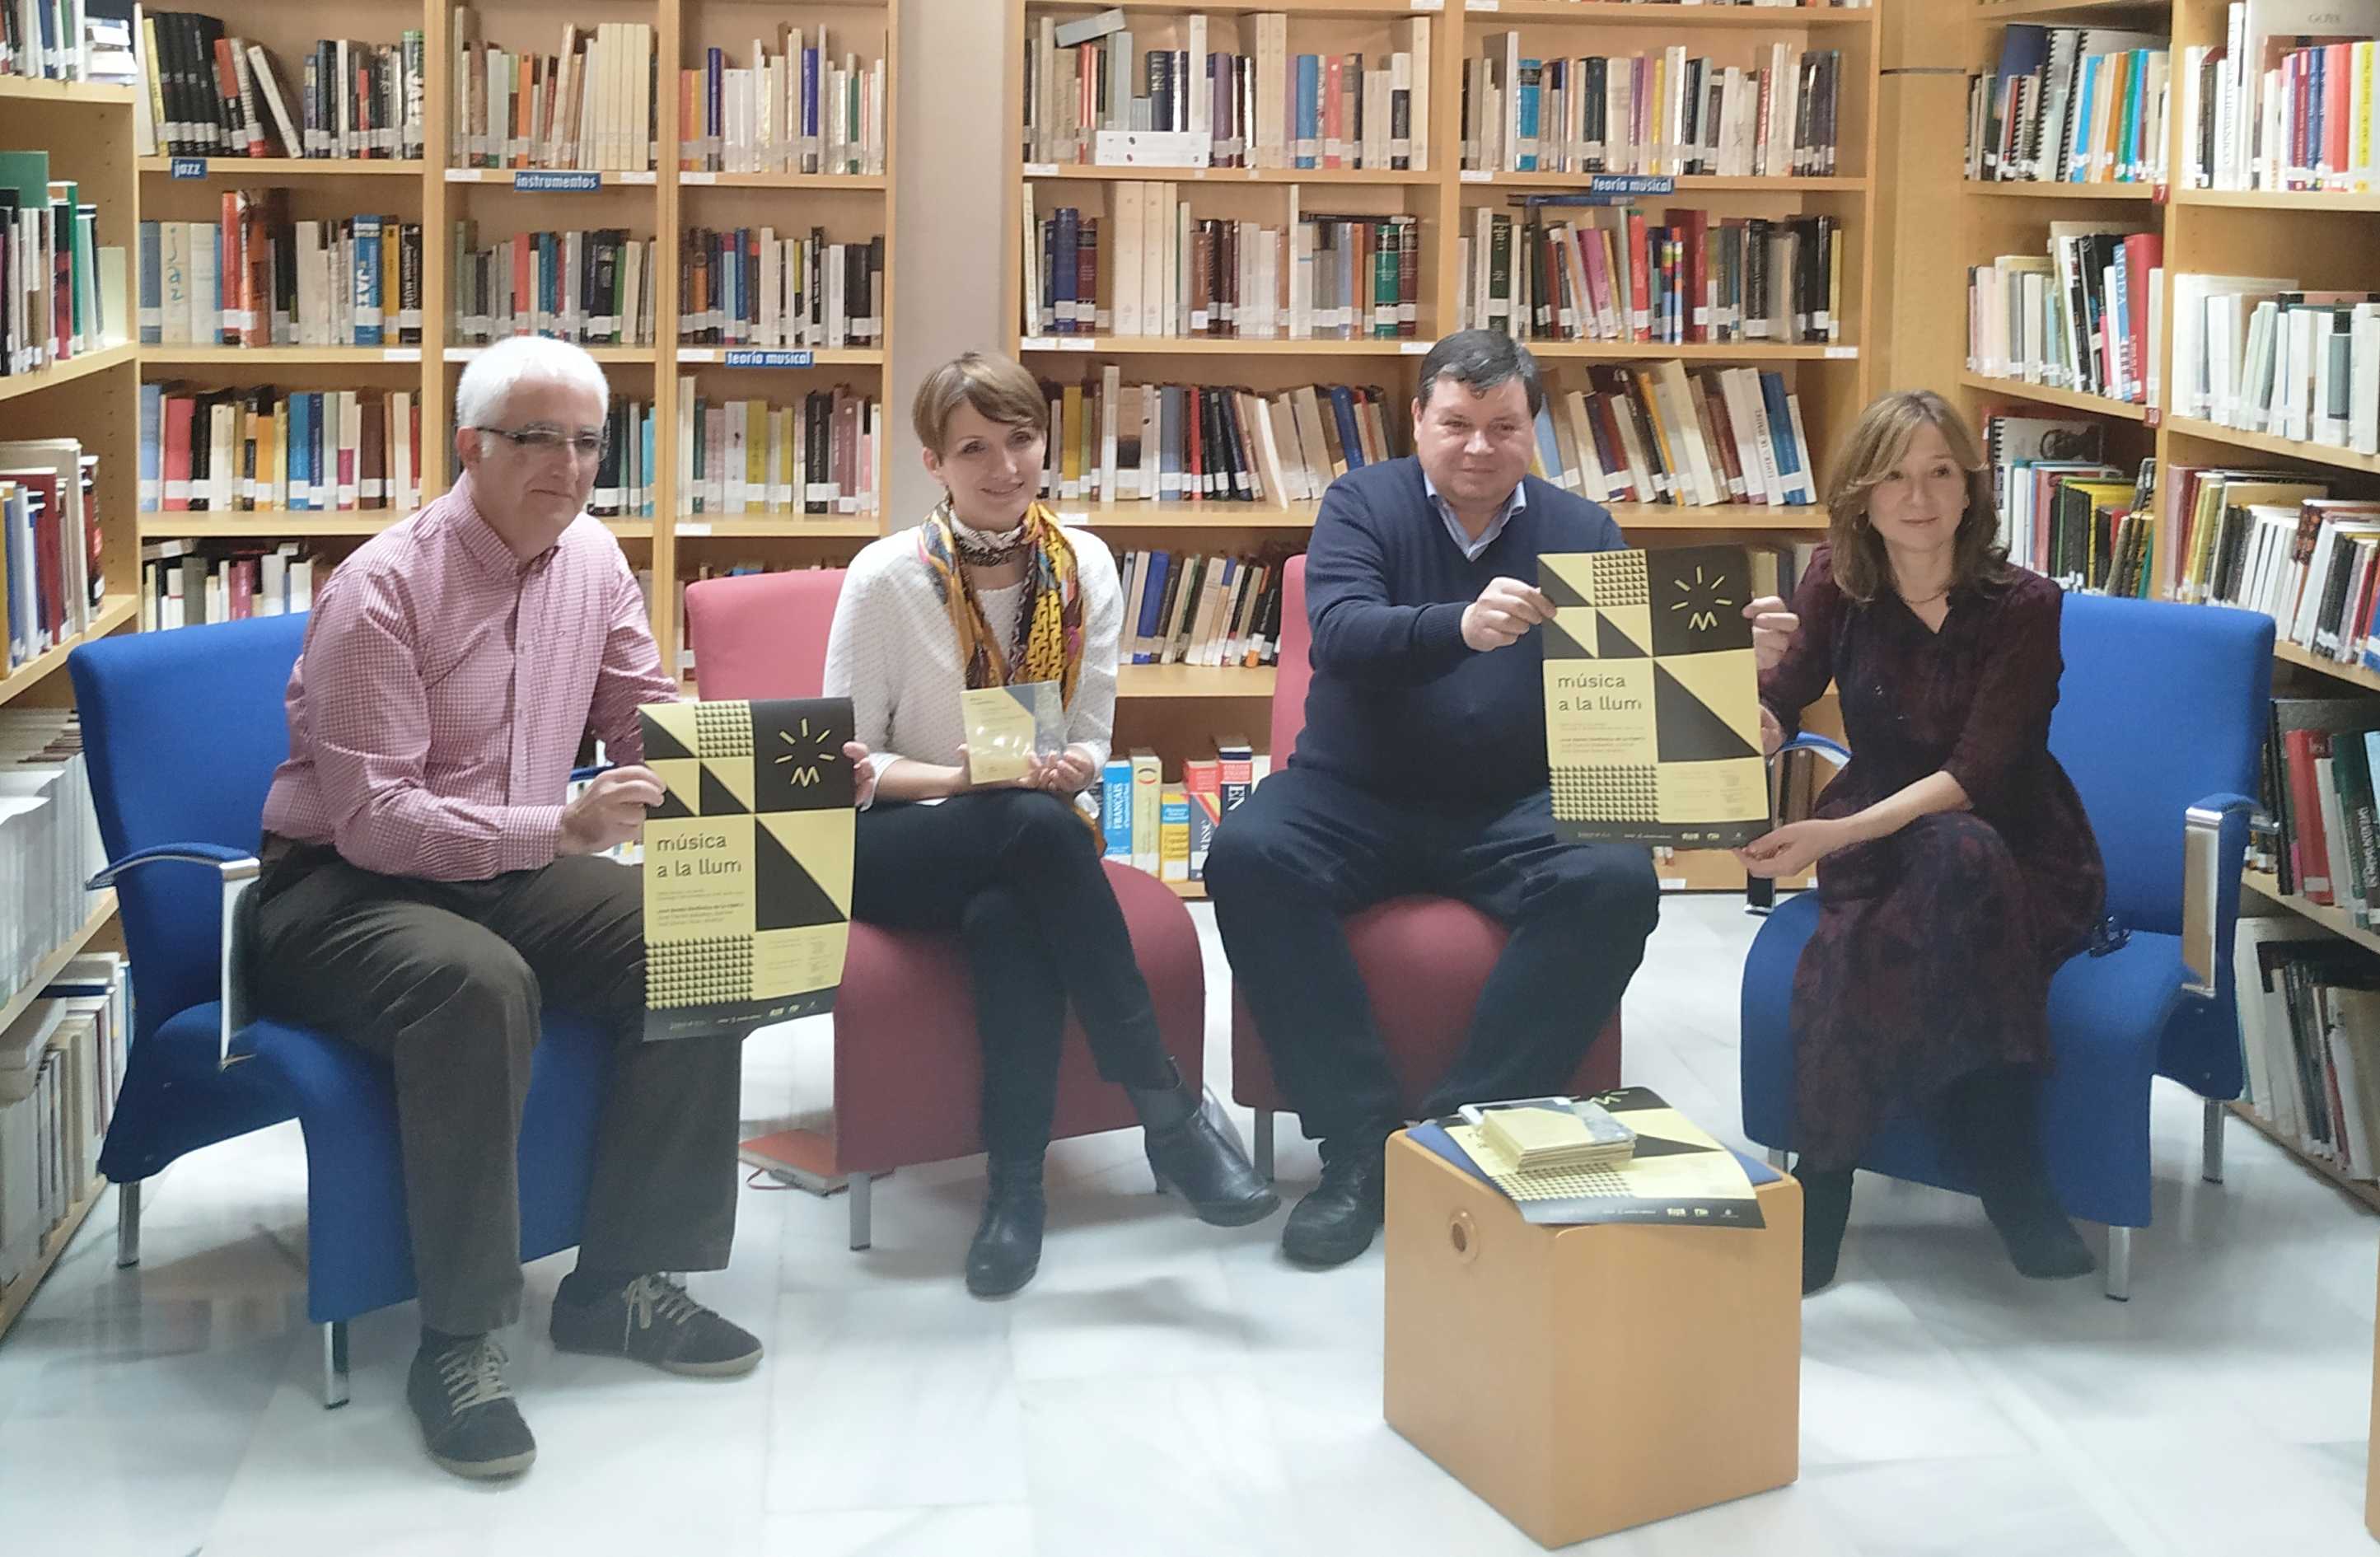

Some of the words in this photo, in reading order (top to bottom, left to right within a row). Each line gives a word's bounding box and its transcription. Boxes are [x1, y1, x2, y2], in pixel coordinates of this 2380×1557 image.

[174, 161, 201, 178] jazz
[516, 173, 597, 189] instrumentos
[1592, 176, 1627, 192] teoría
[1629, 178, 1671, 193] musical
[727, 348, 763, 365] teoría
[765, 349, 811, 365] musical
[1558, 672, 1626, 689] música
[1558, 700, 1569, 712] a
[1576, 697, 1592, 711] la
[1599, 696, 1642, 711] llum
[656, 831, 727, 852] música
[656, 865, 668, 878] a
[675, 861, 692, 877] la
[699, 858, 742, 876] llum
